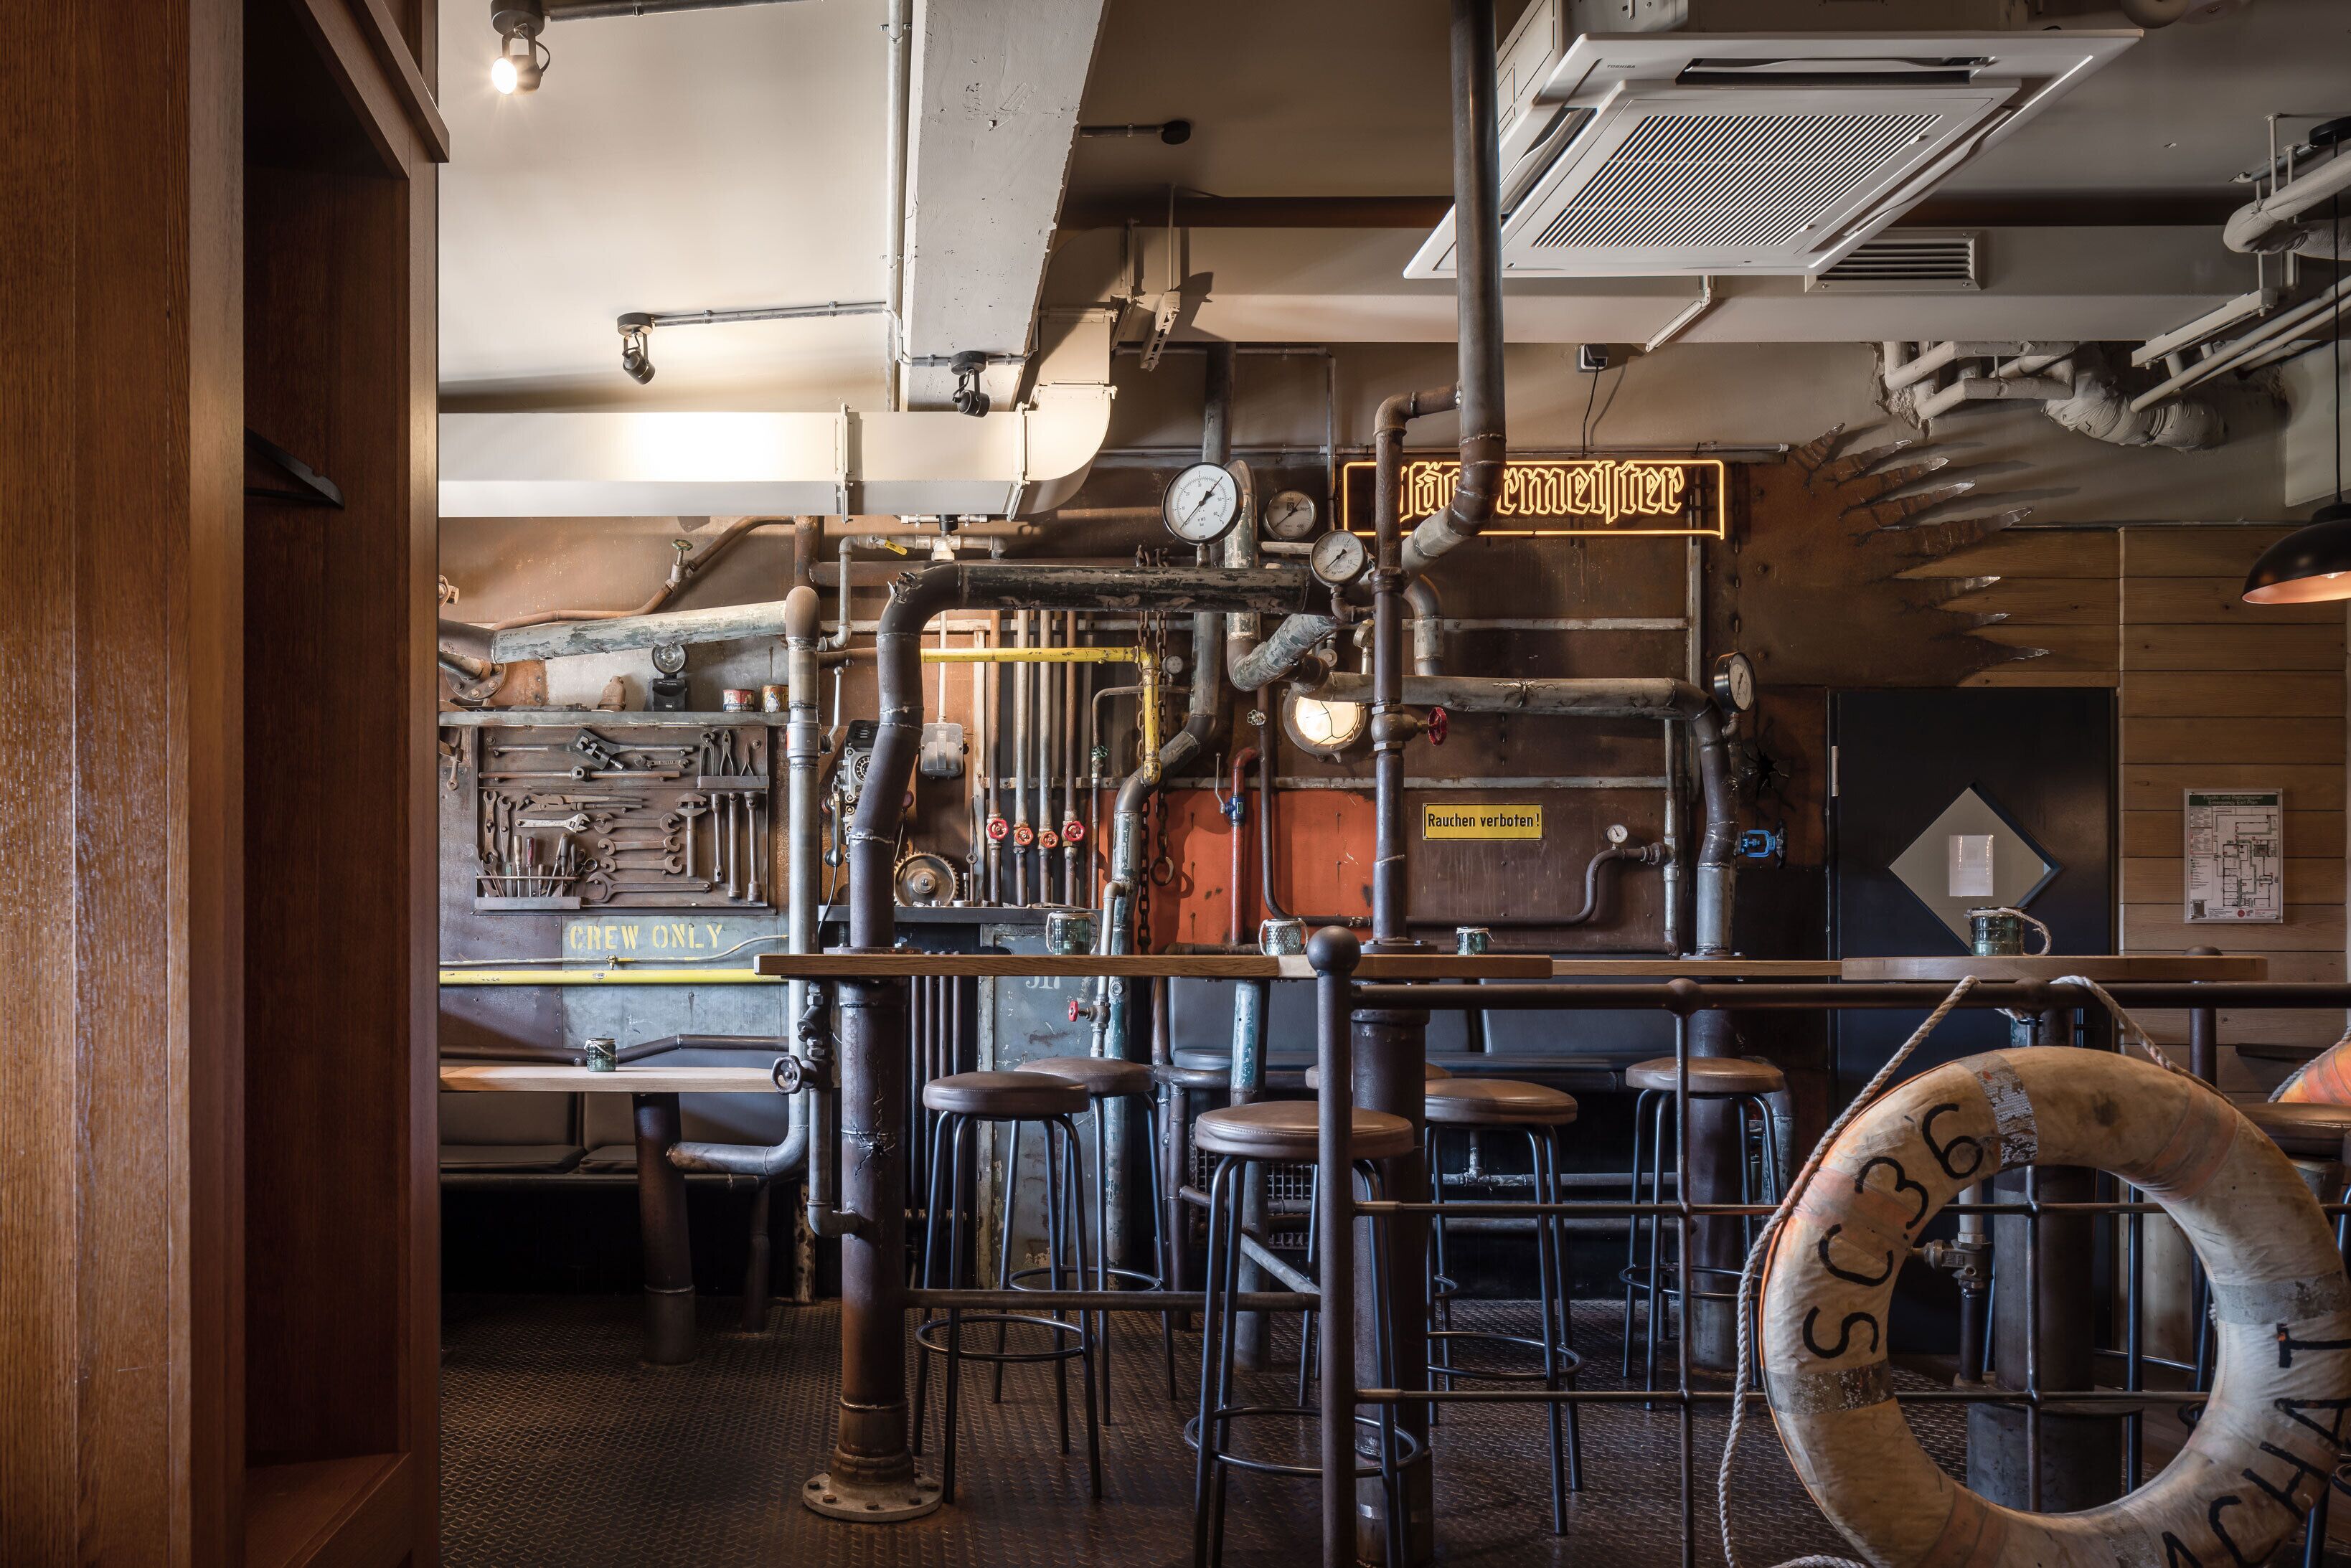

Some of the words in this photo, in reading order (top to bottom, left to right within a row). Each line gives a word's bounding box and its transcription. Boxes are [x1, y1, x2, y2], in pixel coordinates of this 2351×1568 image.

[1427, 813, 1476, 827] Rauchen
[570, 925, 639, 950] CREW
[652, 923, 723, 948] ONLY
